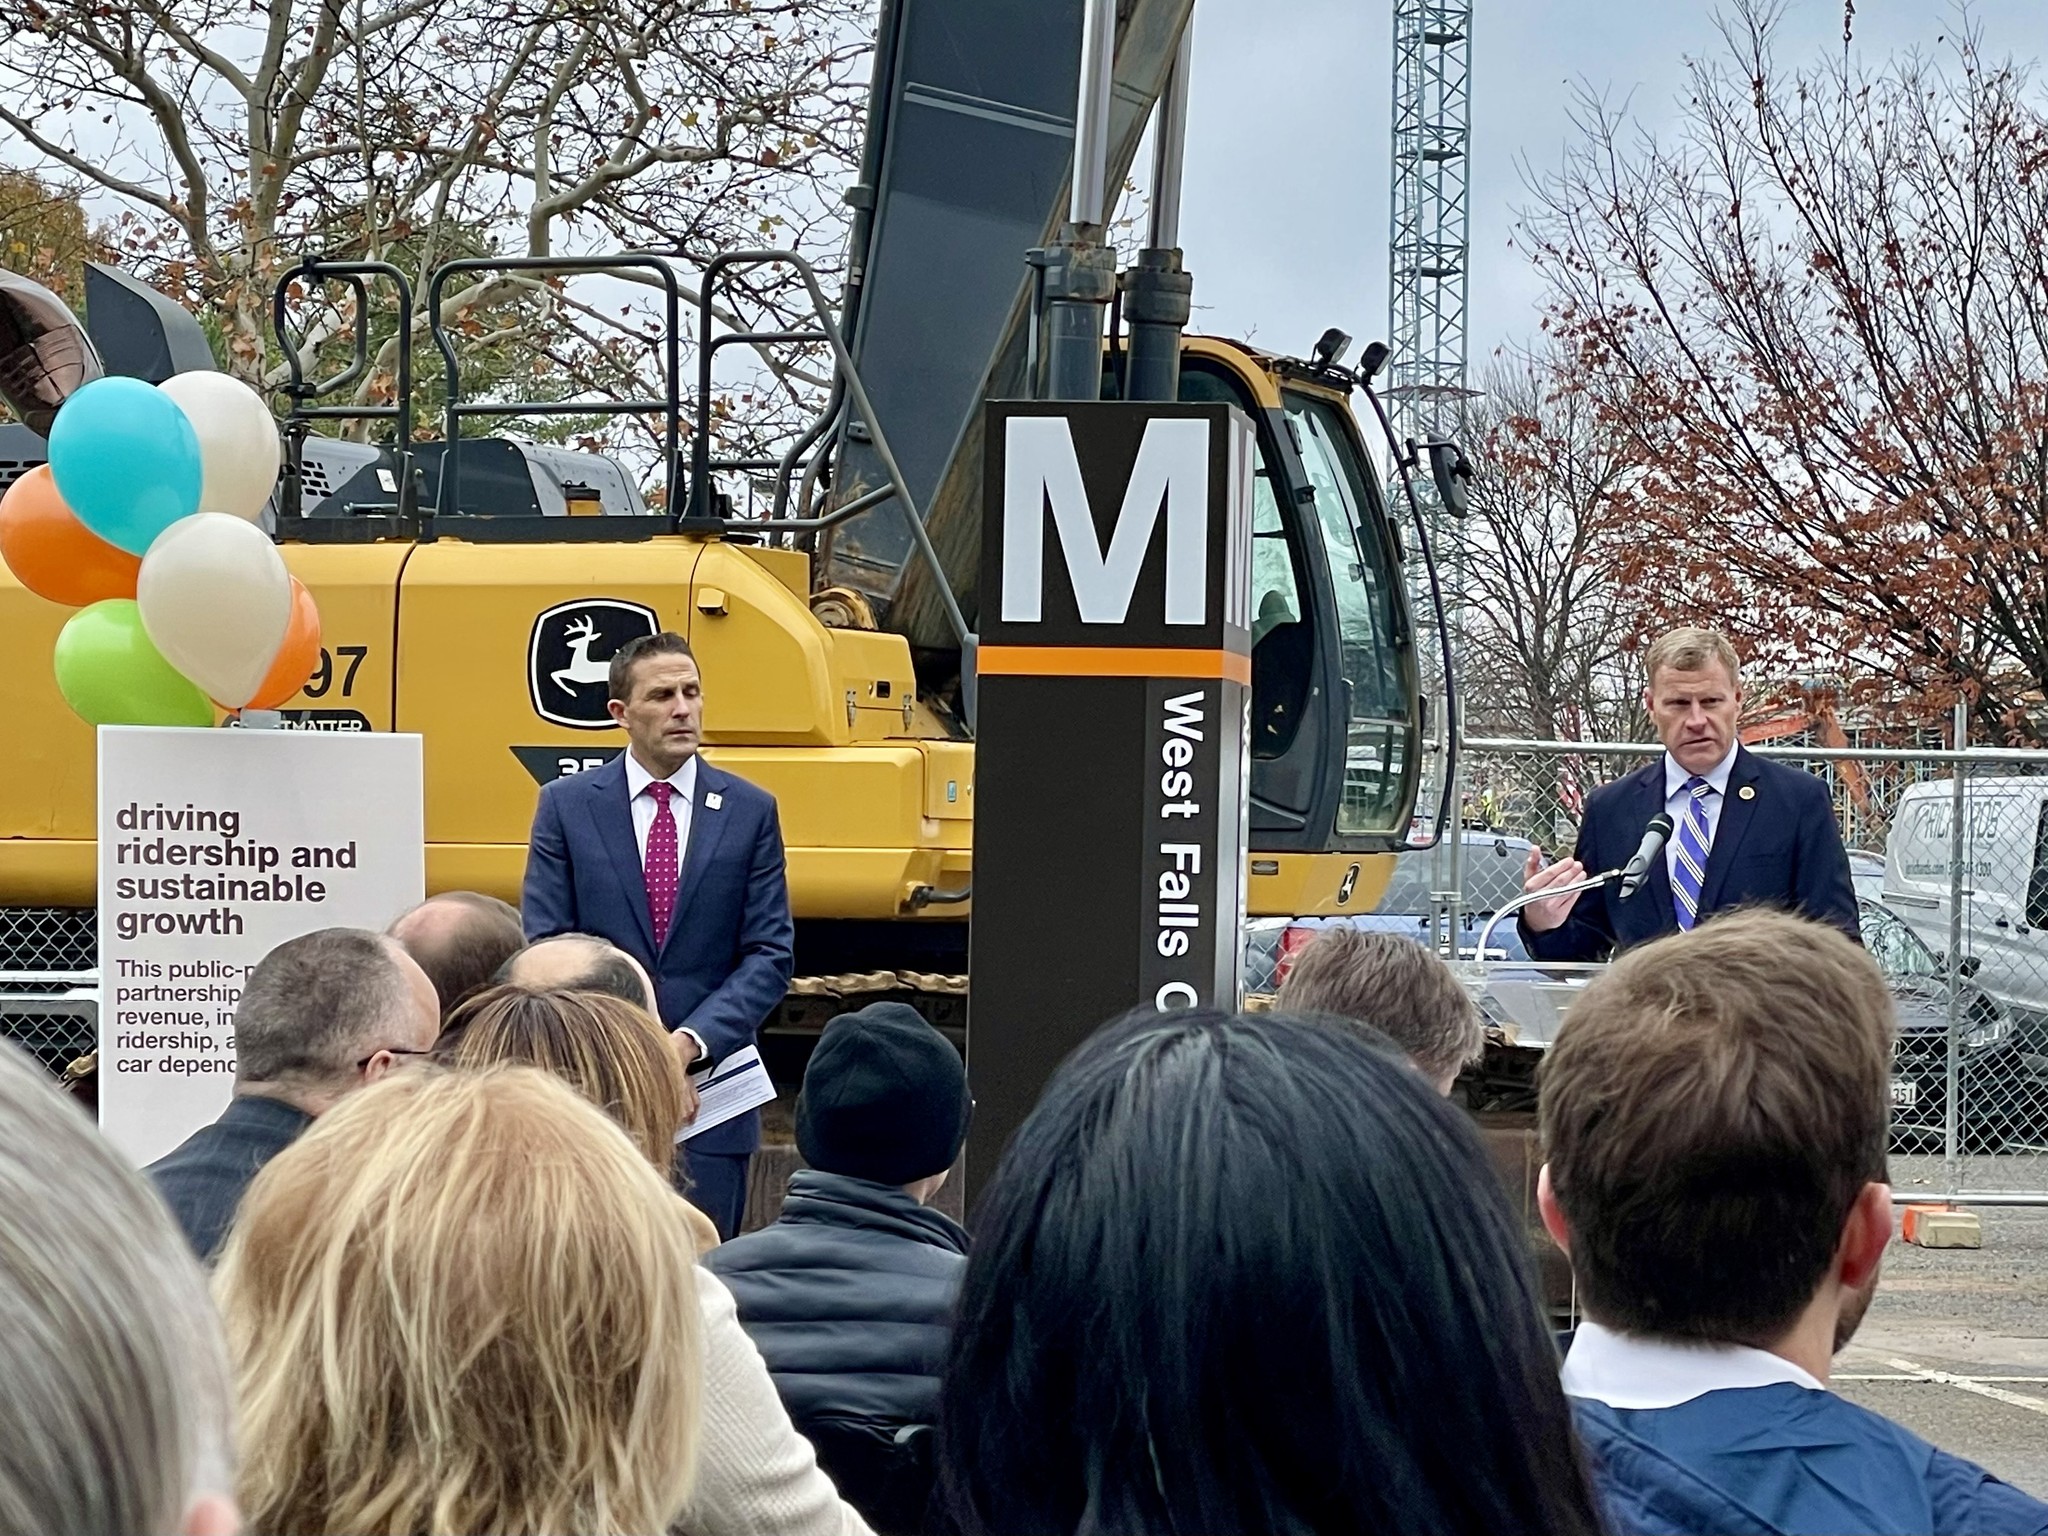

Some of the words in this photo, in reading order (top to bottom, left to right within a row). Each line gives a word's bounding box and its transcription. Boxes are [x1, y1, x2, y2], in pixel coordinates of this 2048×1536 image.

[1001, 416, 1210, 625] M
[1160, 690, 1204, 819] West
[116, 803, 240, 838] driving
[117, 838, 279, 873] ridership
[291, 842, 357, 869] and
[116, 874, 326, 902] sustainable
[1156, 843, 1200, 957] Falls
[116, 908, 244, 940] growth
[116, 959, 162, 977] This
[117, 984, 242, 1006] partnership
[117, 1011, 209, 1029] revenue,
[117, 1031, 219, 1053] ridership,
[117, 1059, 152, 1073] car
